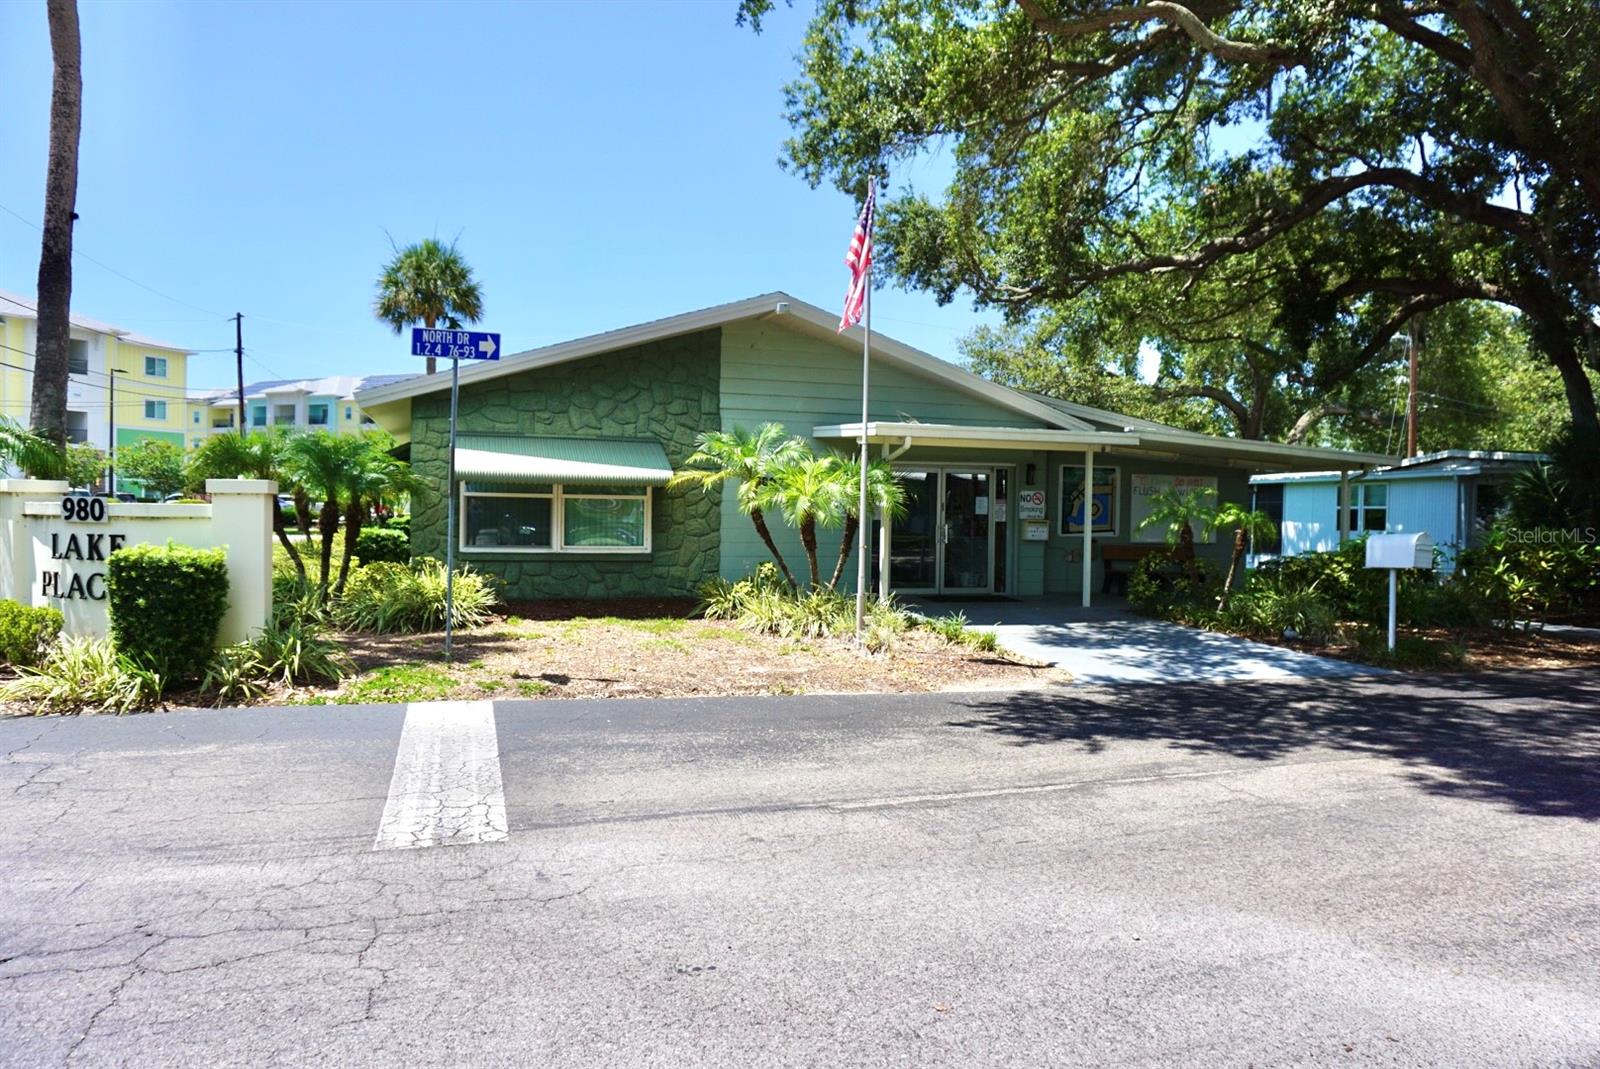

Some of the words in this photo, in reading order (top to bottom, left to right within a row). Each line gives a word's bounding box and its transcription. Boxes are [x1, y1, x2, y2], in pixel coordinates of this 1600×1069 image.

[422, 330, 453, 343] NORTH
[457, 333, 470, 345] DR
[448, 345, 476, 358] 76-93
[1020, 494, 1031, 502] NO
[62, 497, 105, 521] 980
[42, 571, 107, 601] PLAC
